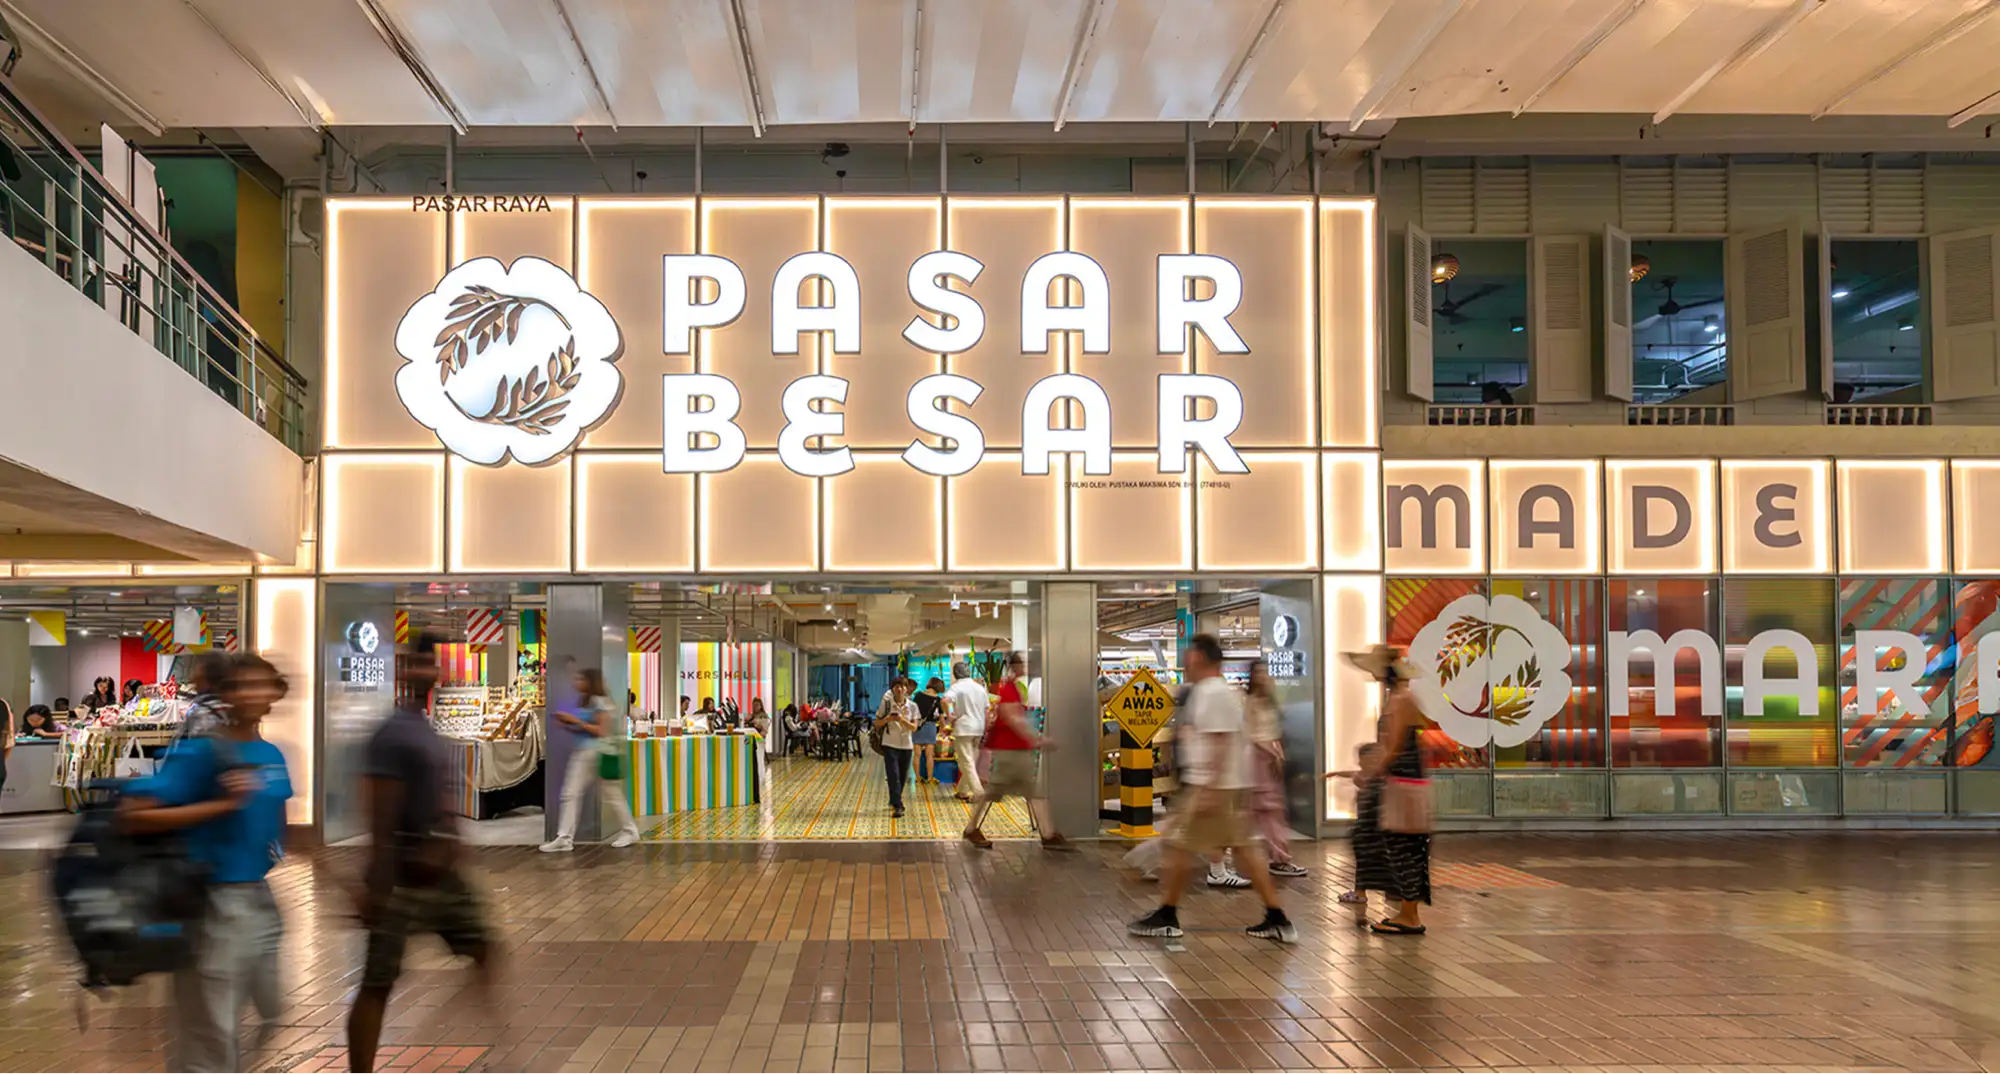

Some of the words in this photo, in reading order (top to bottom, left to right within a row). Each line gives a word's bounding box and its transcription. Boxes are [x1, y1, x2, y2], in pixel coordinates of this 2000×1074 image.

[412, 195, 487, 212] PASAR
[493, 195, 551, 212] RAYA
[662, 249, 1252, 356] PASAR
[662, 373, 1252, 478] BESAR
[1109, 481, 1137, 489] PUSTAKA
[1138, 481, 1167, 489] MAKSIMA
[1386, 482, 1803, 549] MADE
[352, 657, 385, 670] PASAR
[1268, 651, 1294, 664] PASAR
[352, 670, 385, 682] BESAR
[1268, 664, 1294, 677] BESAR
[1123, 697, 1164, 710] AWAS
[1128, 718, 1158, 726] MELINTAS
